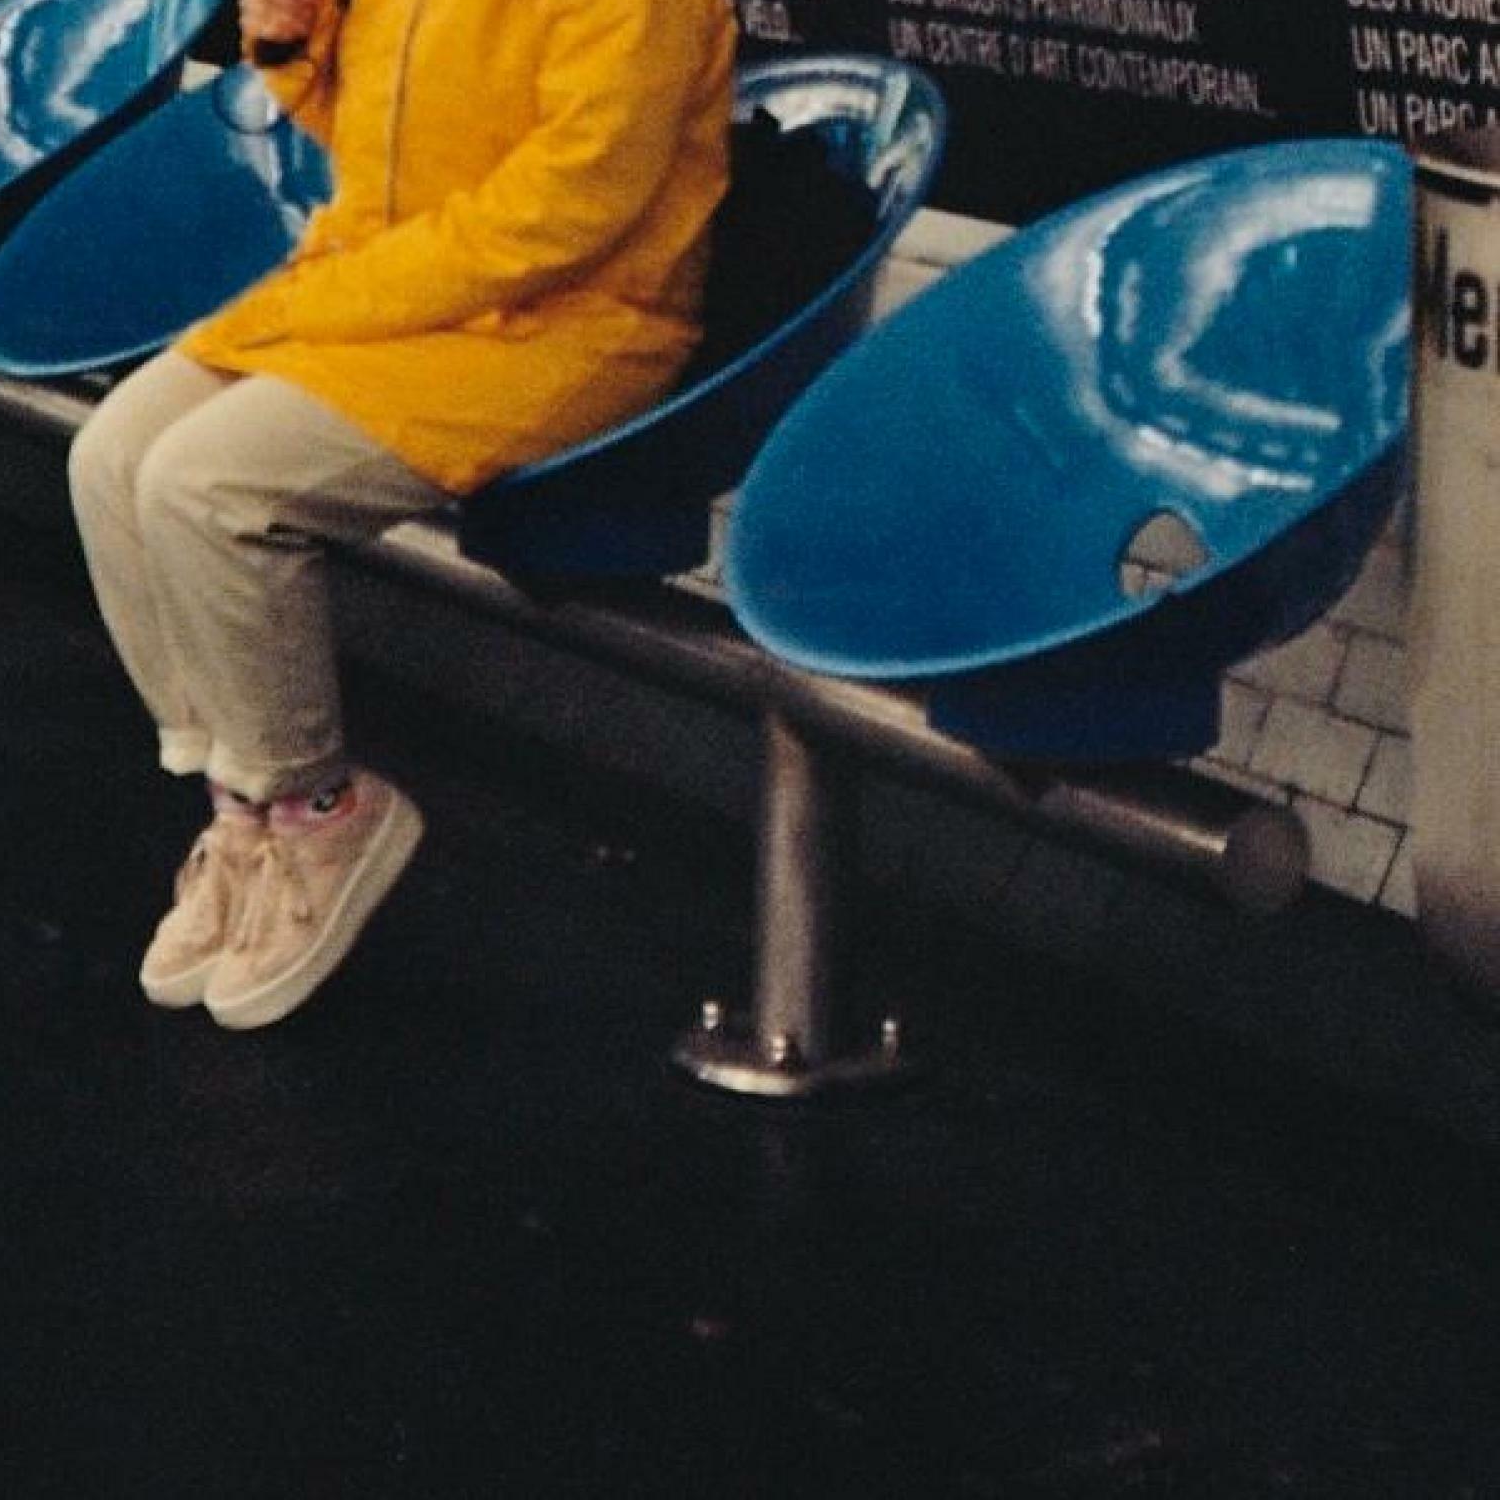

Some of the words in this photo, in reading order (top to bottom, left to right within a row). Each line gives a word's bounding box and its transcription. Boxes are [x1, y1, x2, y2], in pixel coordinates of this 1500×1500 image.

[1350, 24, 1393, 73] UN
[1397, 28, 1472, 87] PARC
[1356, 88, 1399, 136] UN
